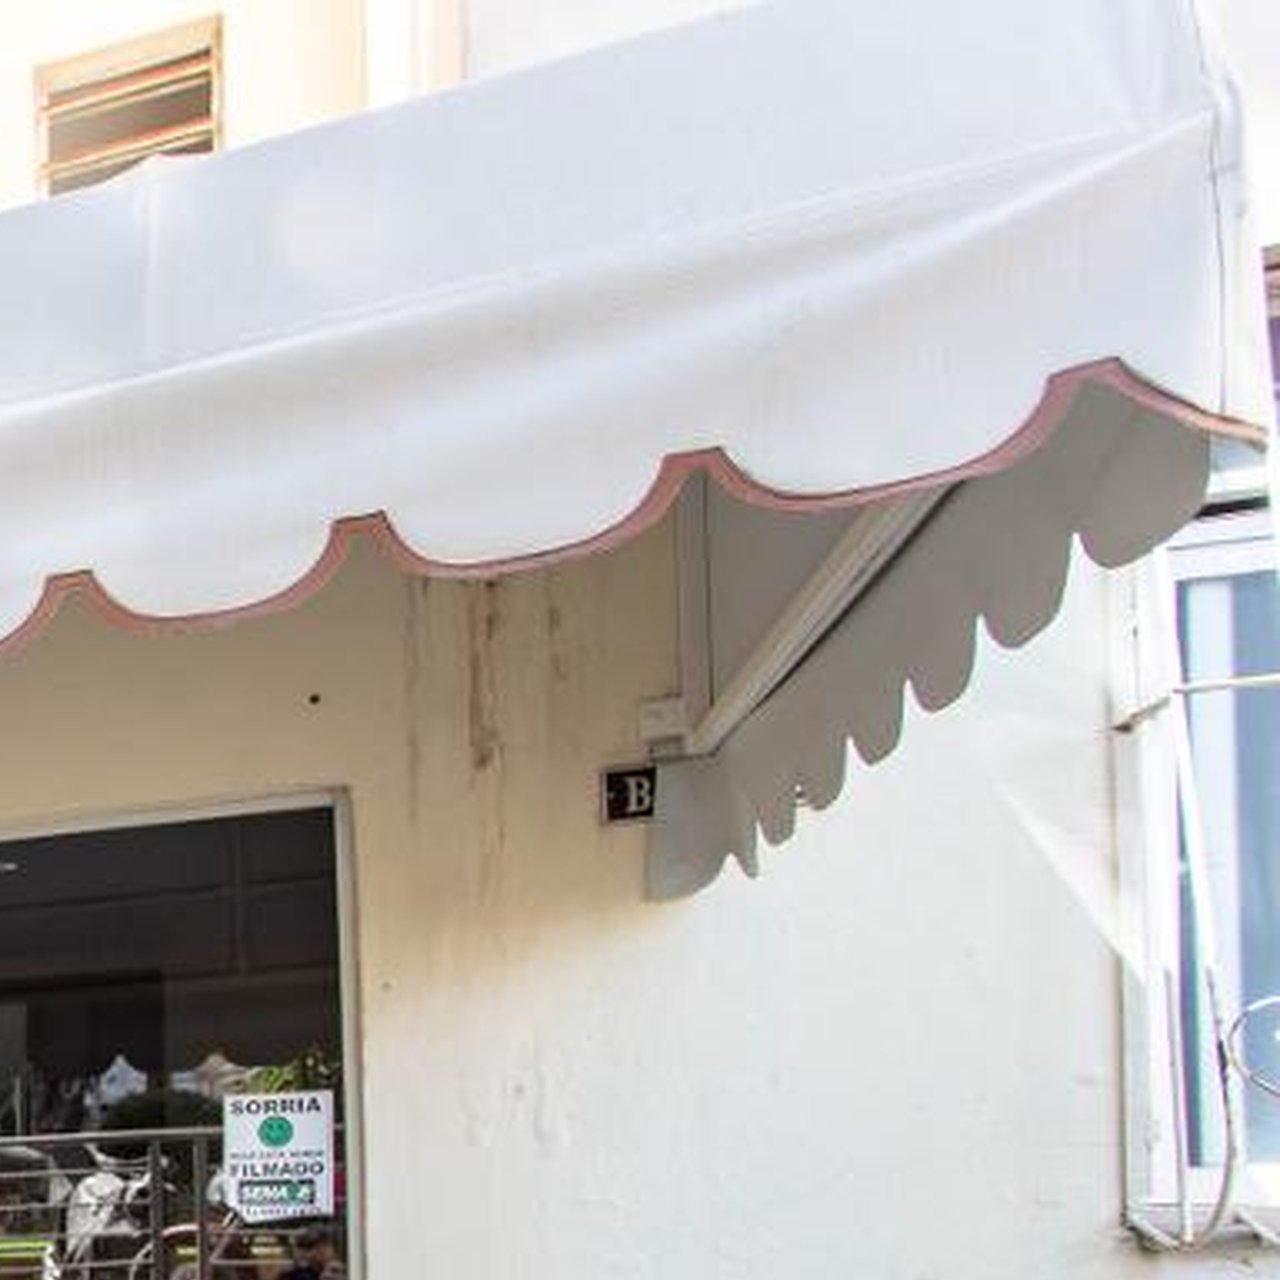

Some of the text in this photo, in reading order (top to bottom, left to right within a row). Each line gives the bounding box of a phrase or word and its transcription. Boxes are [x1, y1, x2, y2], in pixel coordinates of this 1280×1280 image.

[624, 775, 651, 813] B
[229, 1097, 321, 1115] SORRIA
[229, 1161, 324, 1177] FILMADO
